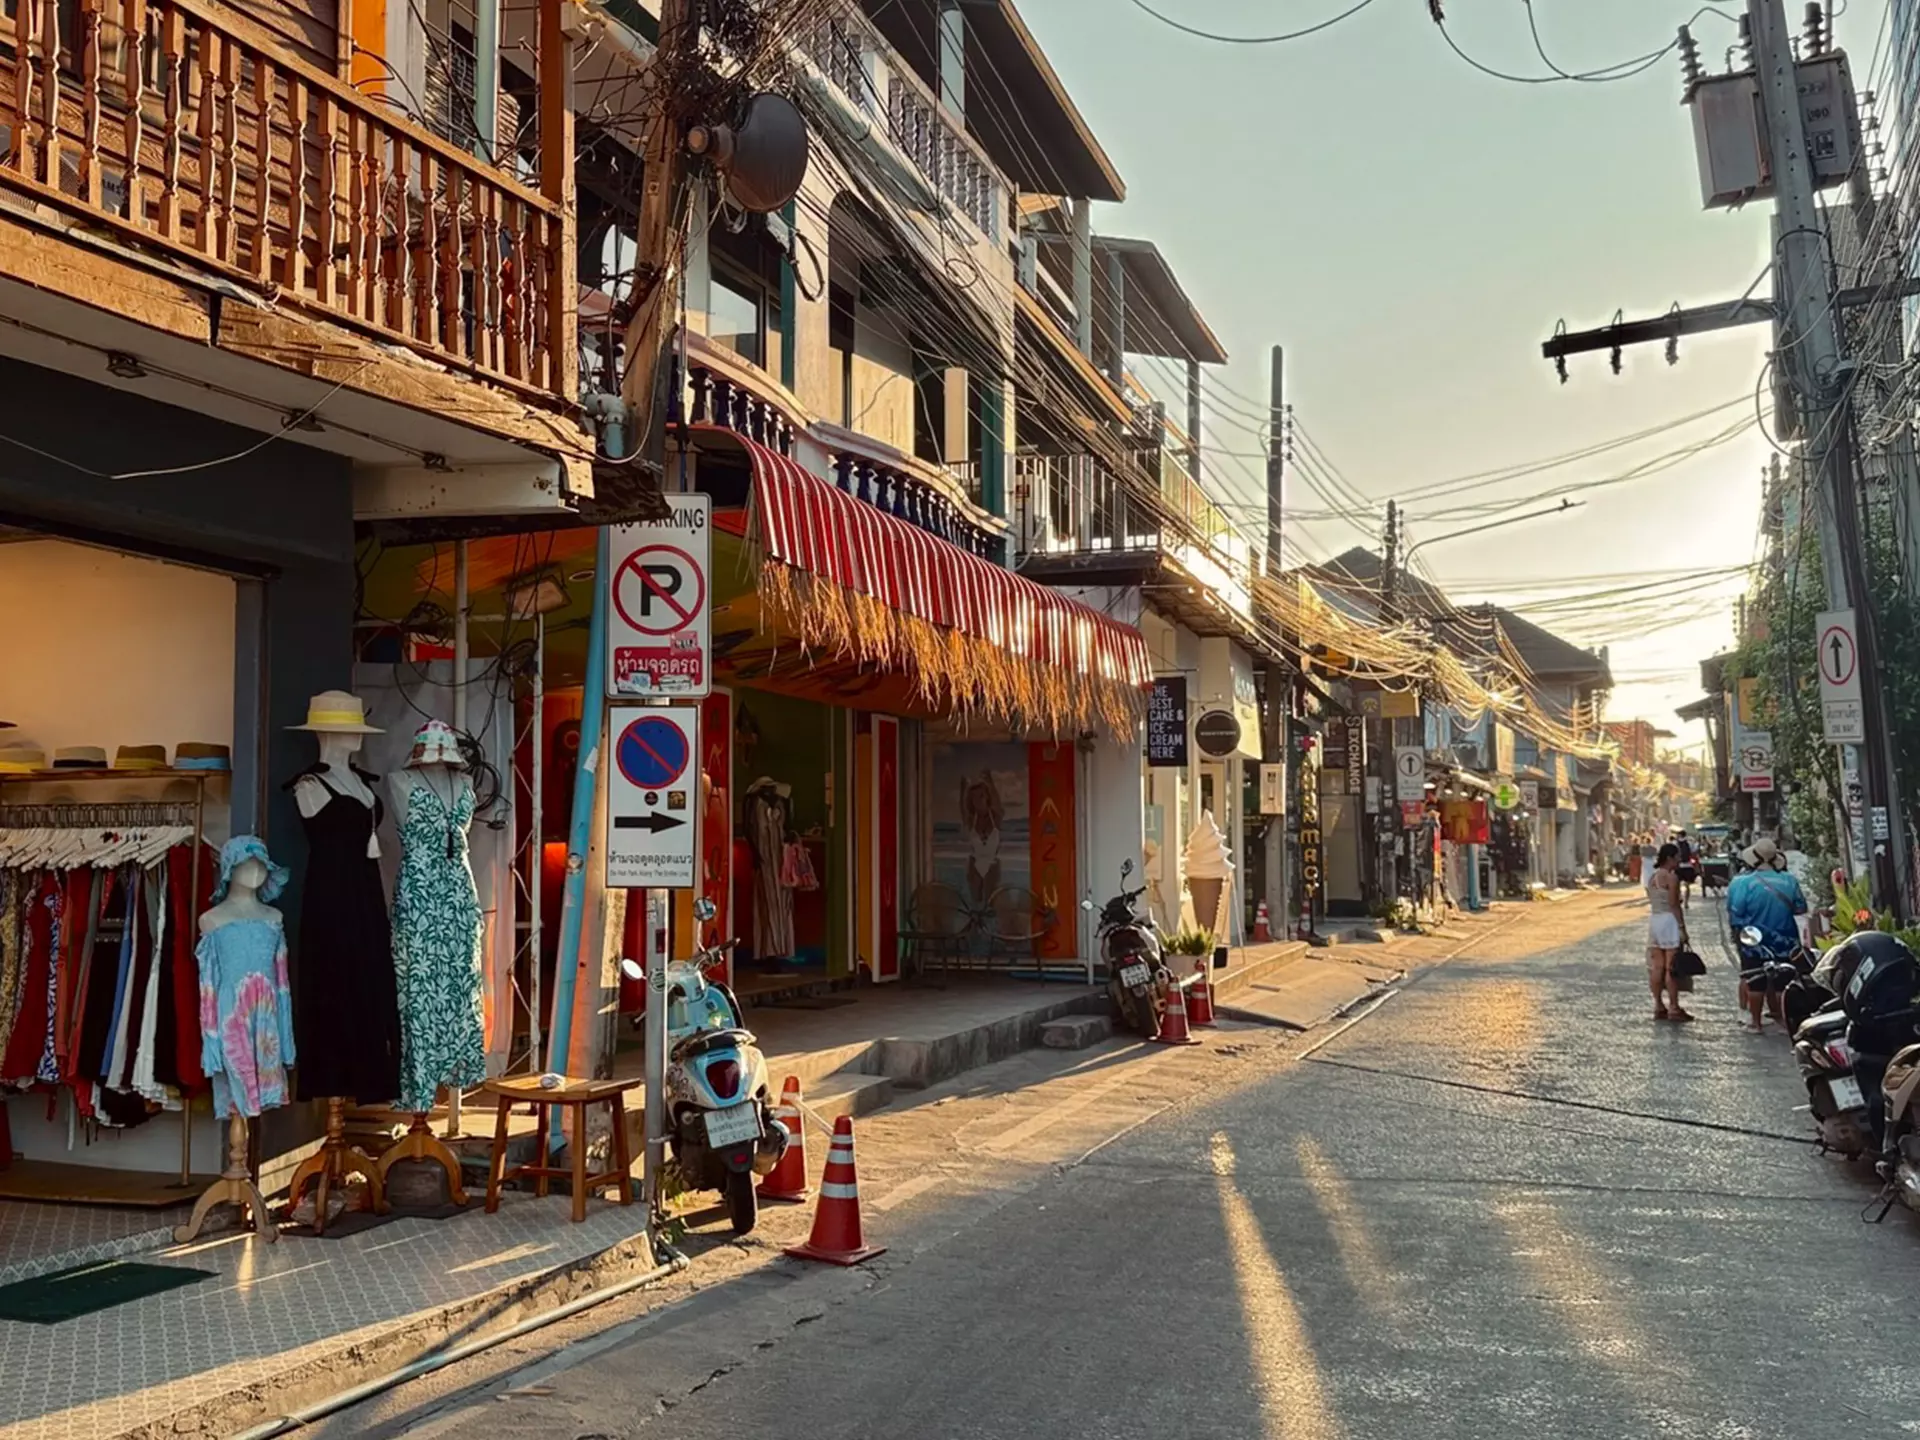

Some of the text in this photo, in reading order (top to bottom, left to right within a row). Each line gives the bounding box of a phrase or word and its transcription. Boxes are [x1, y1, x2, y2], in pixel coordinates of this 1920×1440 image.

[617, 650, 700, 673] ห้ามจอดรถ
[1149, 698, 1173, 709] BEST
[1150, 709, 1184, 721] CAKE &
[1150, 722, 1164, 733] ICE
[1150, 734, 1183, 745] CREAM
[1150, 746, 1175, 758] HERE
[1347, 728, 1360, 793] EXCHANGE
